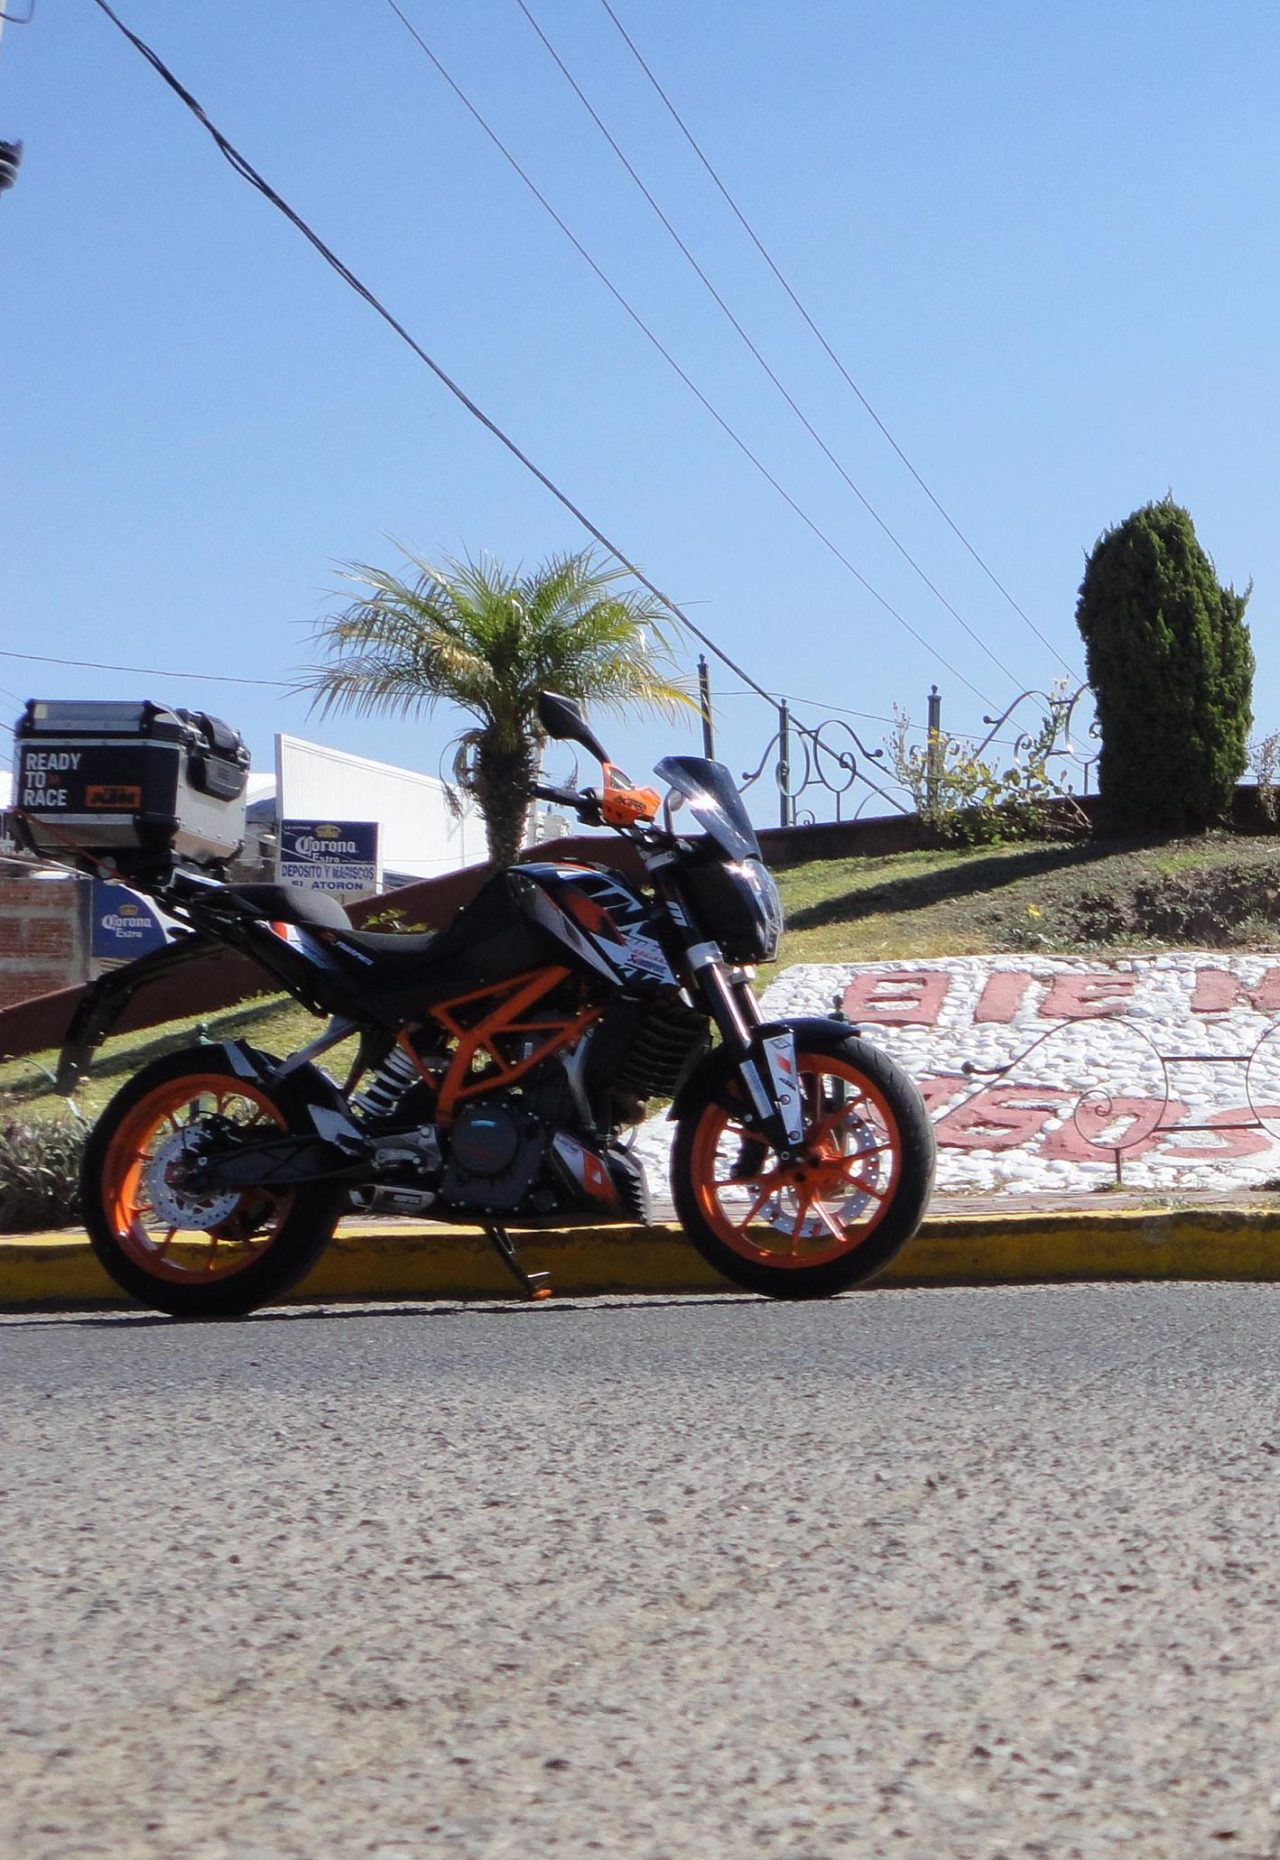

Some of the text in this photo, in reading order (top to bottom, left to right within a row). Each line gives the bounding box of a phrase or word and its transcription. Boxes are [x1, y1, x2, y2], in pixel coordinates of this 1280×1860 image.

[26, 753, 82, 770] READY
[26, 771, 47, 787] TO
[24, 788, 68, 807] RACE
[294, 836, 357, 857] Corona
[312, 881, 363, 890] ATORON
[101, 914, 152, 931] Corona
[115, 928, 143, 938] Extra
